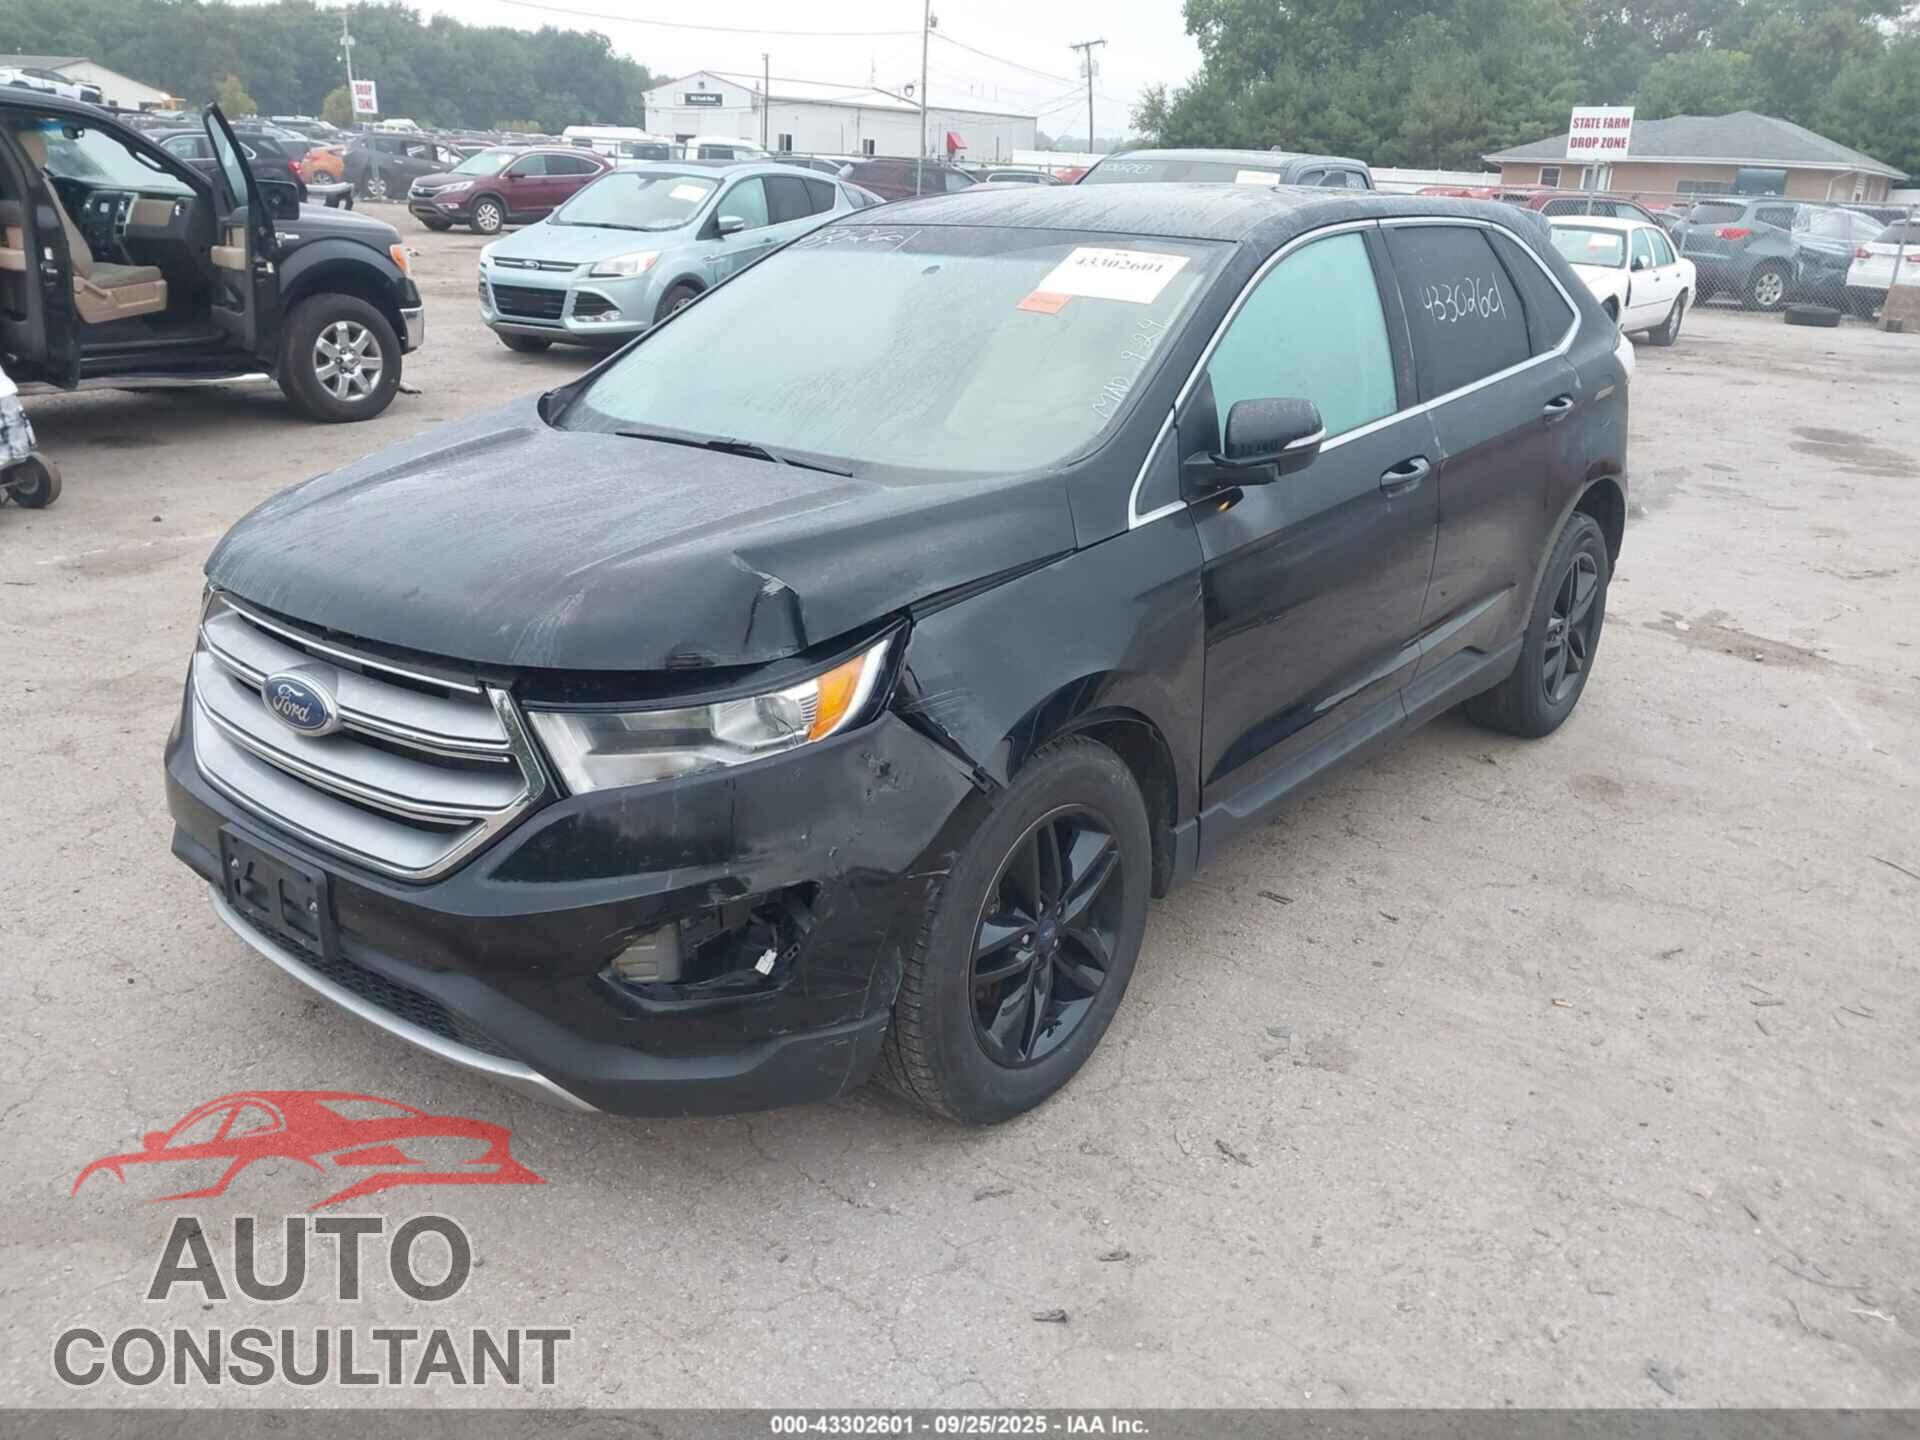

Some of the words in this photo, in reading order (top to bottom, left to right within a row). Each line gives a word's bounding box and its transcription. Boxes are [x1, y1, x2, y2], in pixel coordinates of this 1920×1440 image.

[1573, 117, 1600, 128] STATE
[1602, 117, 1630, 128] FARM
[1570, 137, 1599, 148] DROP
[1600, 137, 1627, 148] ZONE
[272, 684, 313, 722] Ford
